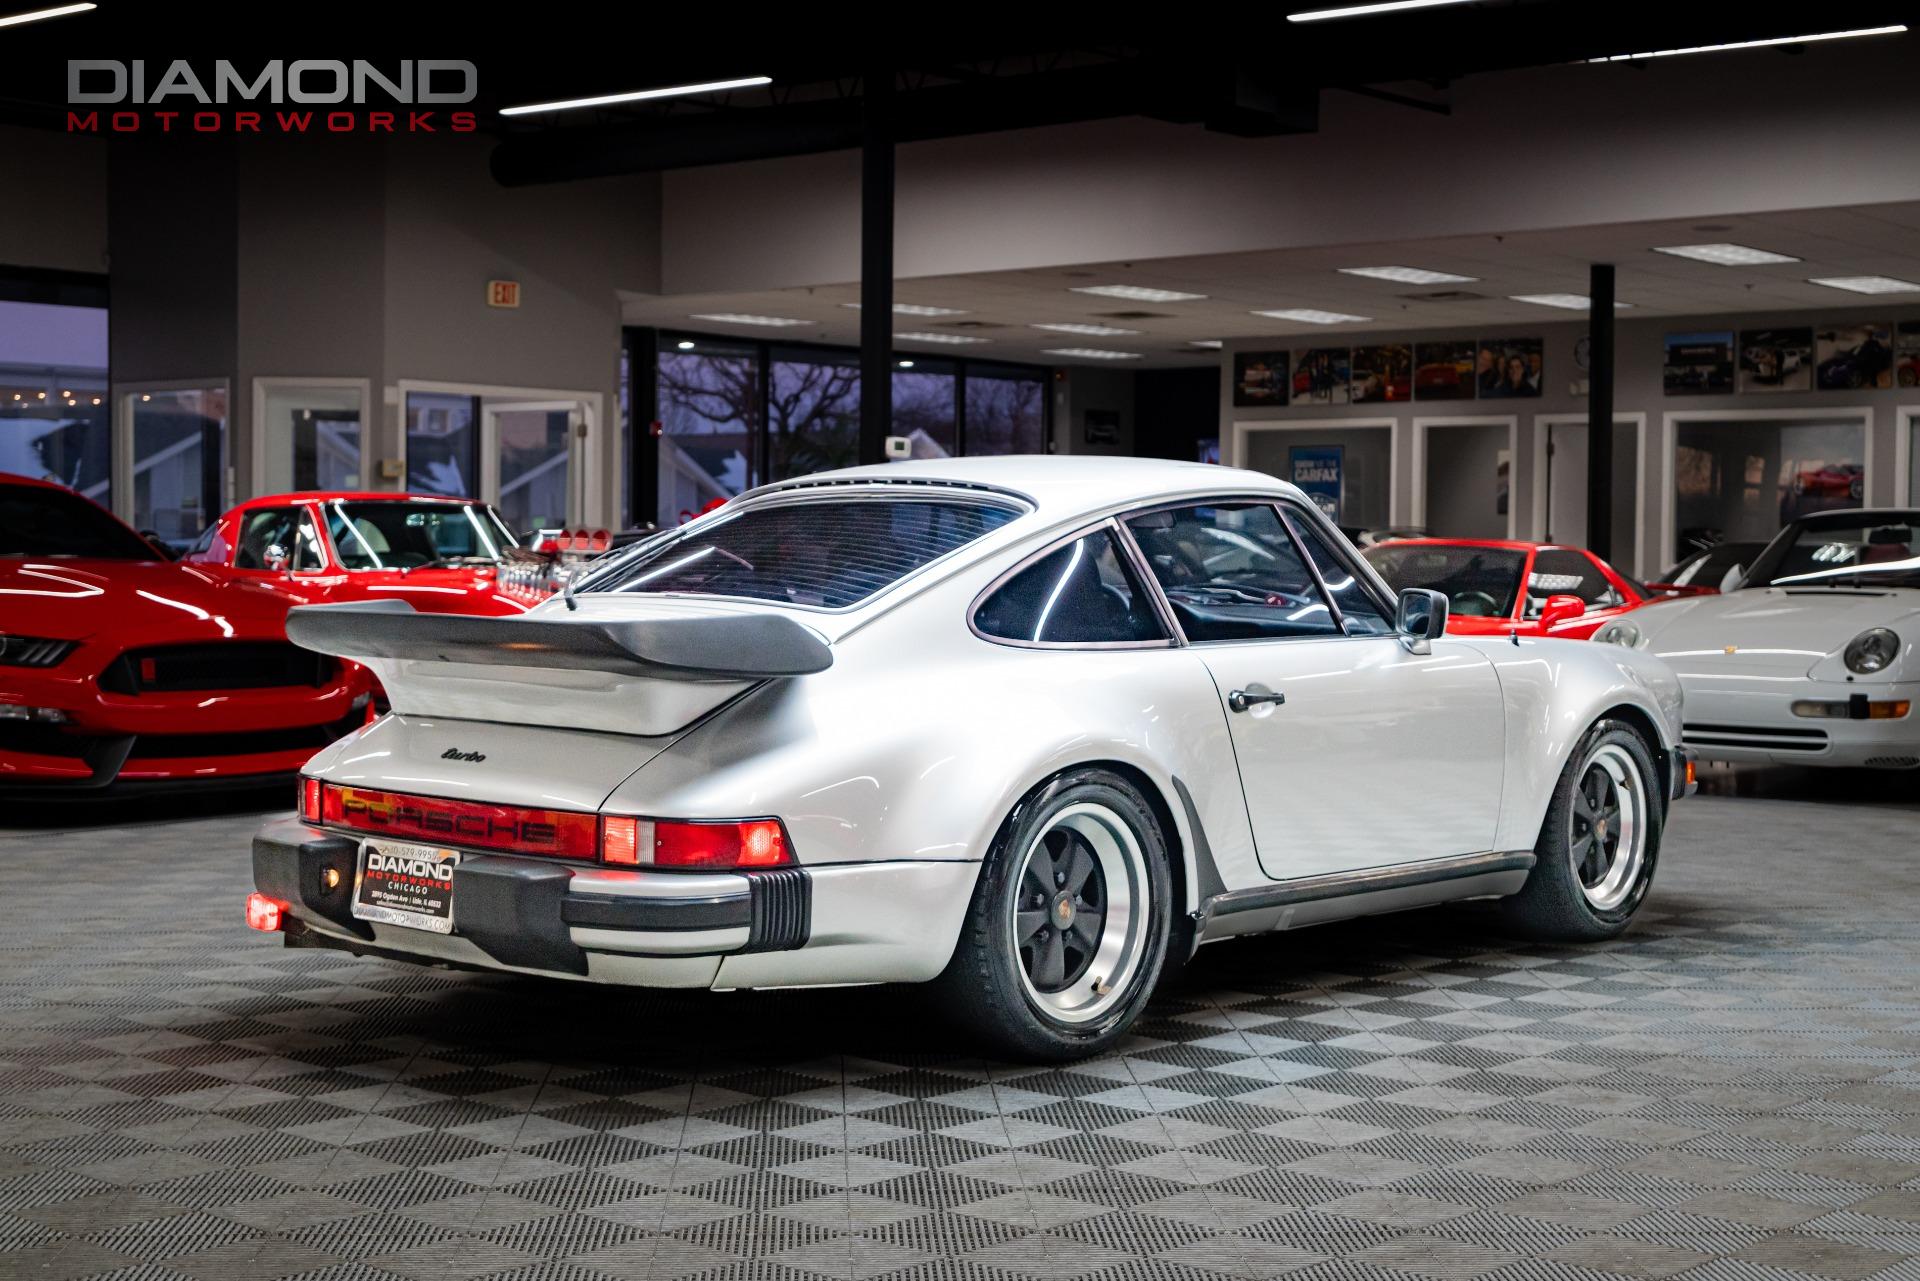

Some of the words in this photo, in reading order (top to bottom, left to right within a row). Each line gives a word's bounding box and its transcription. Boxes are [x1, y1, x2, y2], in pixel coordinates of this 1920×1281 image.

[495, 282, 517, 305] EXIT
[1295, 468, 1338, 482] CARFAX
[440, 747, 487, 763] turbo
[344, 799, 556, 843] PORSCHE
[367, 853, 453, 881] DIAMOND
[366, 870, 452, 892] MOTORWORKS
[387, 881, 428, 895] CHICAGO
